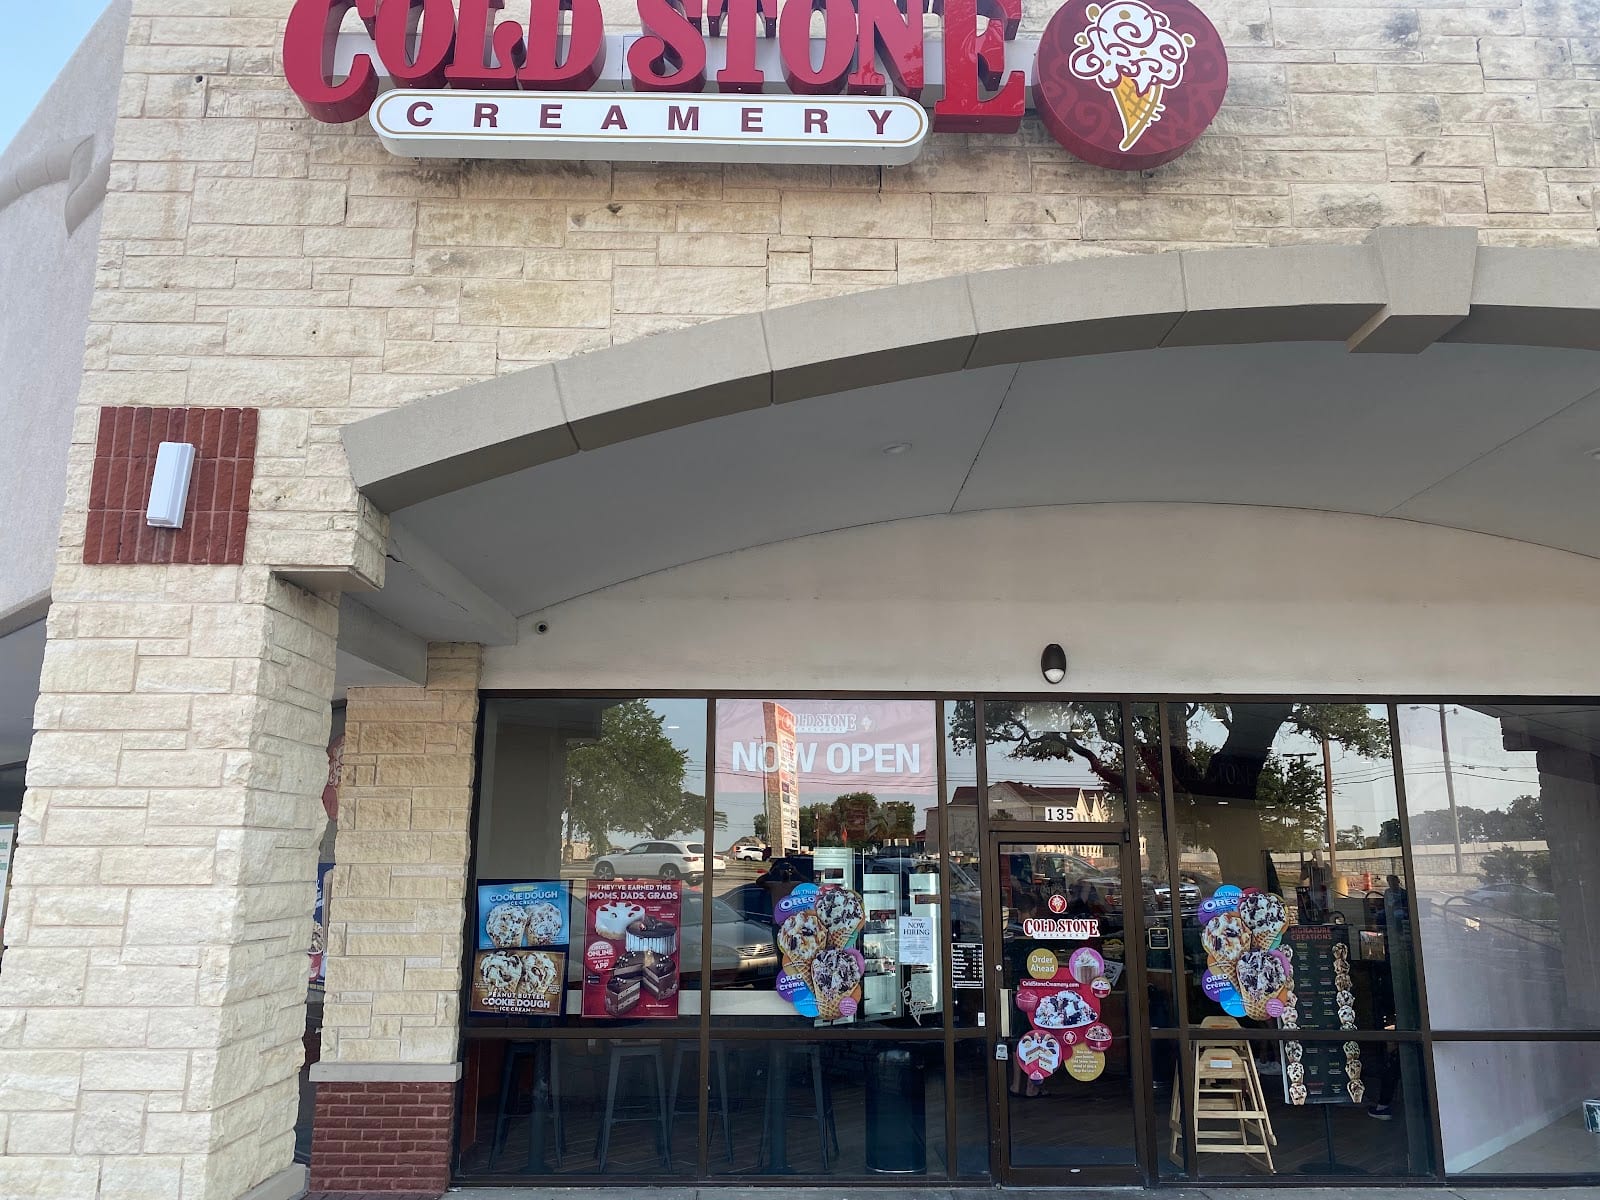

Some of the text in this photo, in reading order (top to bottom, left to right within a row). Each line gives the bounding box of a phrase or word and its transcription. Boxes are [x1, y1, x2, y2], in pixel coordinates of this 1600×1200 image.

[282, 0, 1026, 126] COLD STONE
[405, 100, 894, 136] CREAMERY
[815, 714, 857, 731] STONE
[732, 741, 921, 775] NOW OPEN
[1047, 808, 1074, 821] 135
[489, 890, 558, 902] COOKIE DOUGH
[589, 892, 678, 900] MOMS, DADS, GRADS
[779, 896, 816, 911] OREO
[1203, 897, 1239, 912] OREO
[1024, 919, 1099, 936] COLD STONE
[587, 949, 614, 957] ONLINE
[1031, 955, 1053, 964] Order
[1030, 964, 1055, 973] Ahead
[1206, 974, 1228, 983] OREO
[481, 997, 551, 1009] COOKIE DOUGH
